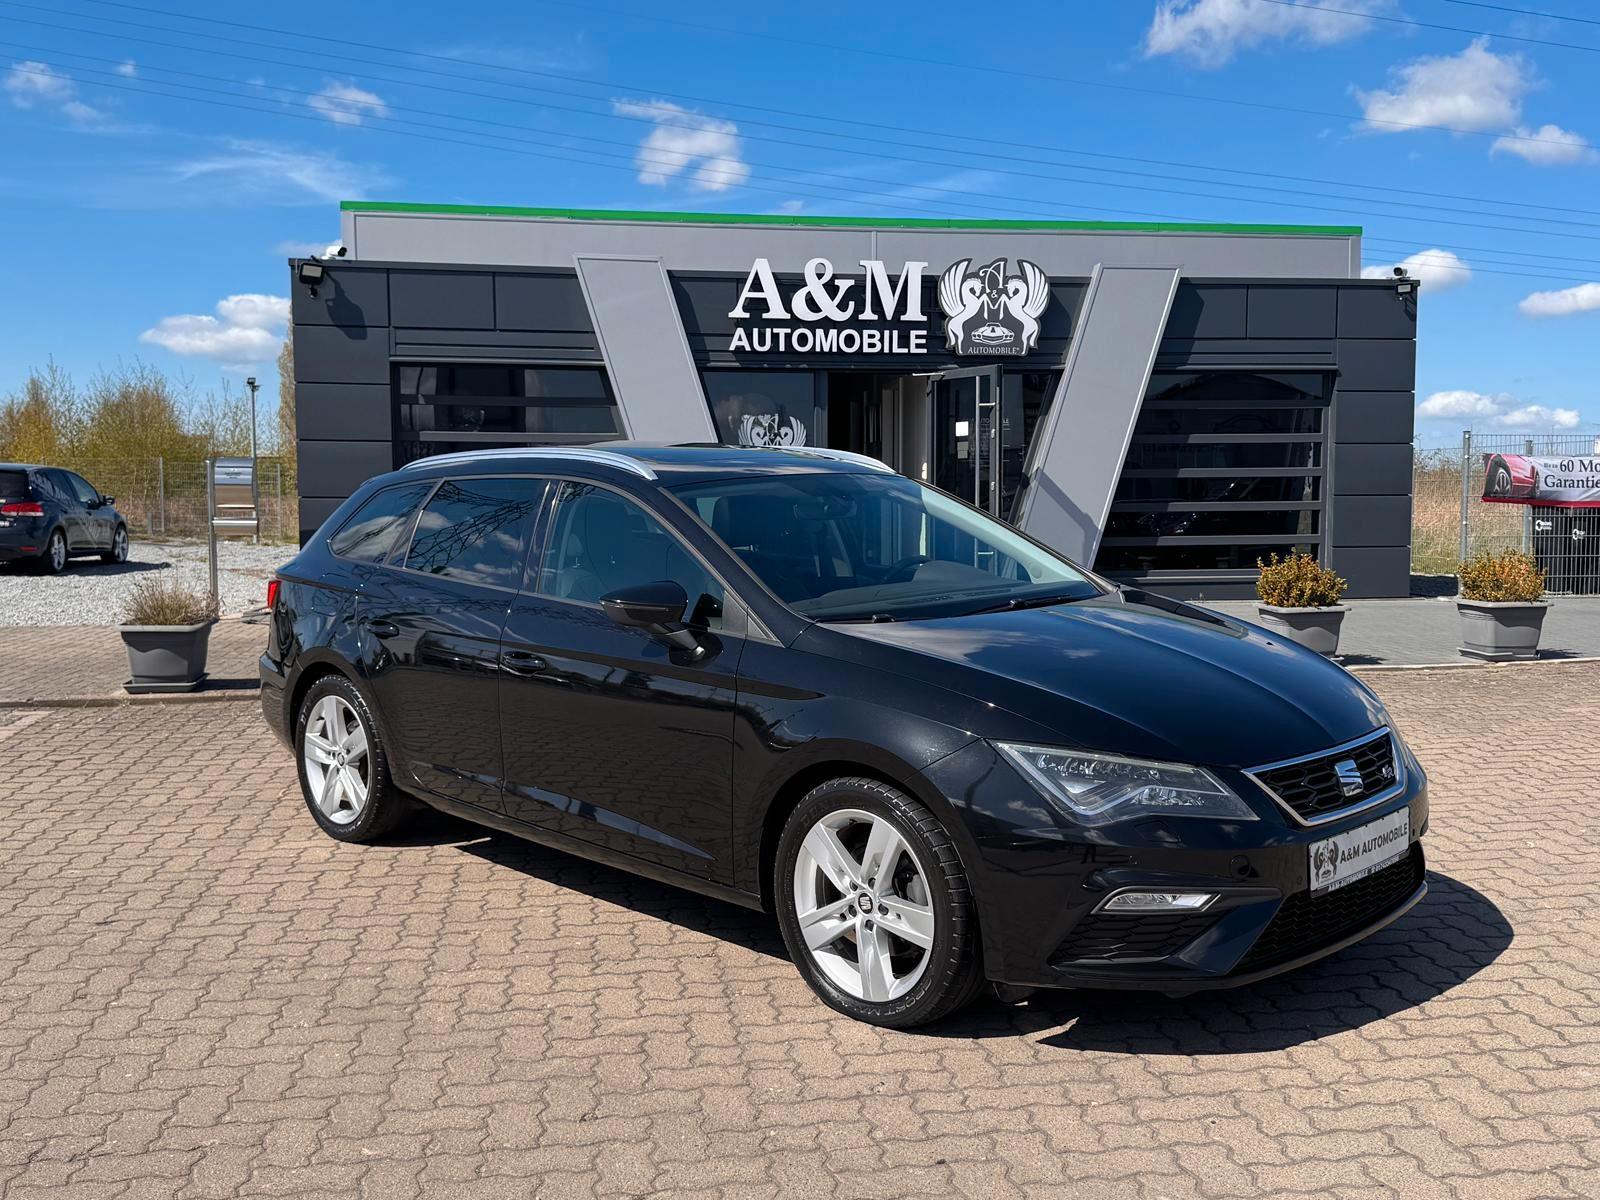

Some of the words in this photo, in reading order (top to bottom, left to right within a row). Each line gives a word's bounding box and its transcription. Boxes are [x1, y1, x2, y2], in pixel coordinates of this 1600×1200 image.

[728, 257, 928, 322] A&M
[728, 327, 928, 354] AUTOMOBILE
[1560, 459, 1574, 472] 60
[1544, 474, 1600, 489] Garantie
[1339, 844, 1360, 864] A&M
[1361, 823, 1407, 856] AUTOMOBILE
